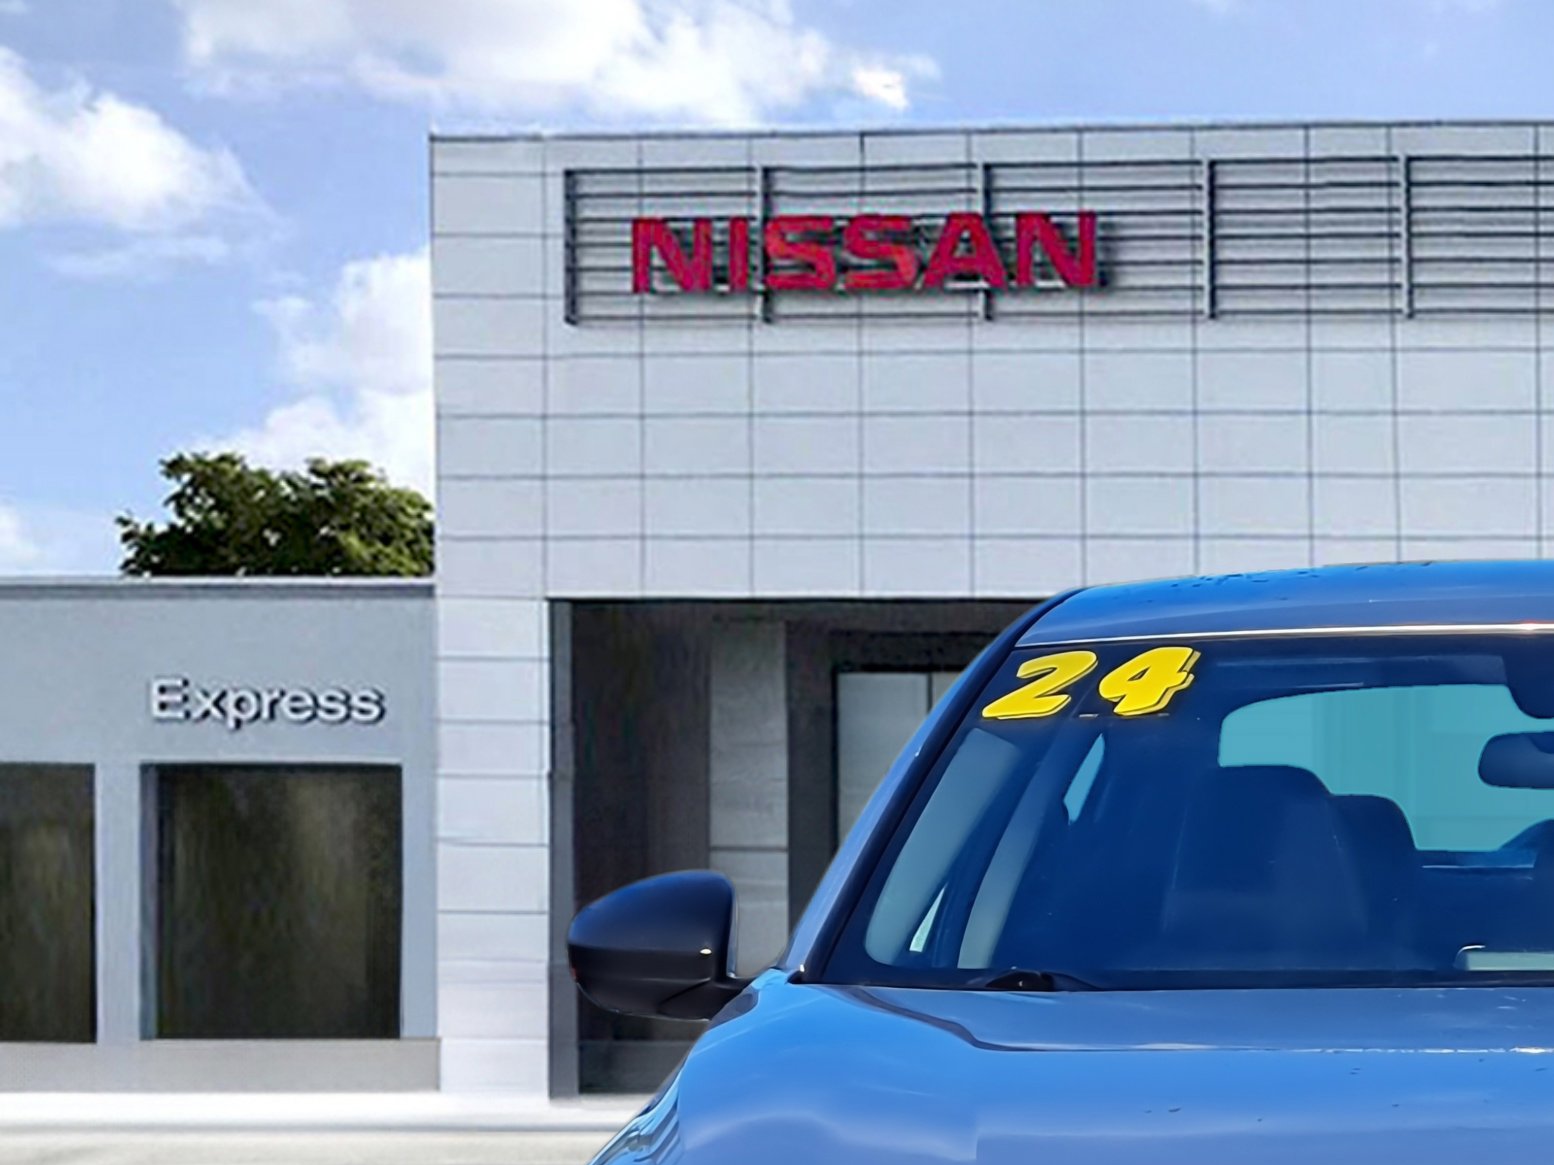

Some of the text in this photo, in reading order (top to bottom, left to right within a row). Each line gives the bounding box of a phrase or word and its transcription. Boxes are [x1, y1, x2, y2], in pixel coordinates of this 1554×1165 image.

[632, 210, 1097, 294] NISSAN
[151, 677, 386, 732] Express
[982, 646, 1201, 720] 24
